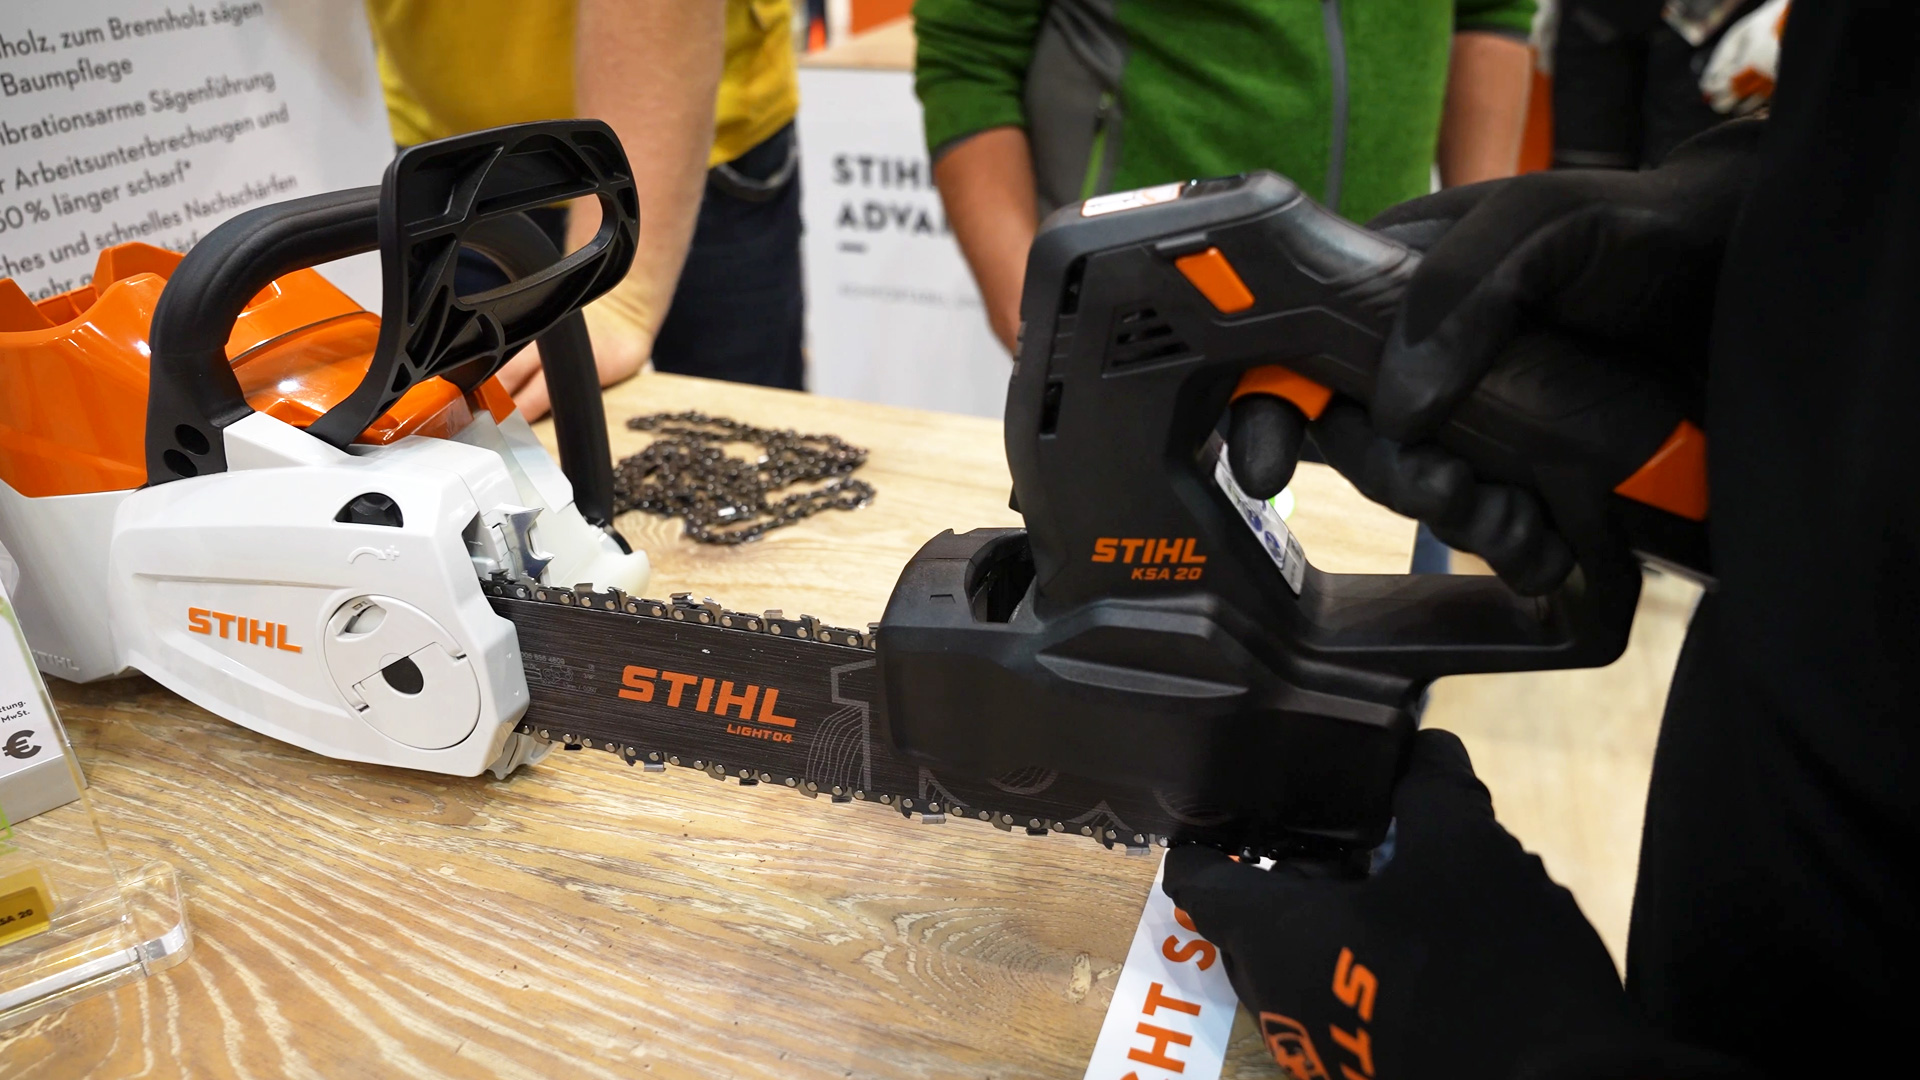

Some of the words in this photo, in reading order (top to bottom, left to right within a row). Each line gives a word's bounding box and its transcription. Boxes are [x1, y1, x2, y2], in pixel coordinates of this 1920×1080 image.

[0, 29, 56, 58] holz,
[60, 27, 105, 49] zum
[107, 5, 206, 41] Brennholz
[212, 3, 263, 26] sägen
[0, 58, 133, 97] Baumpflege
[148, 72, 276, 113] Sägenführung
[15, 117, 254, 190] Arbeitsunterbrechungen
[258, 102, 290, 128] und
[51, 231, 91, 264] und
[94, 210, 182, 249] schnelles
[184, 173, 297, 222] Nachschärfen
[54, 186, 121, 216] länger
[1091, 537, 1207, 564] STIHL
[1131, 567, 1170, 581] KSA
[1174, 567, 1203, 580] 20
[187, 607, 302, 653] STIHL
[31, 649, 80, 671] TIHL
[0, 701, 26, 713] tung.
[618, 664, 797, 728] STIHL
[1, 710, 30, 723] MwSt.
[2, 729, 42, 759] €
[18, 908, 34, 919] 20
[1119, 981, 1202, 1080] HT
[1328, 946, 1379, 1080] ST
